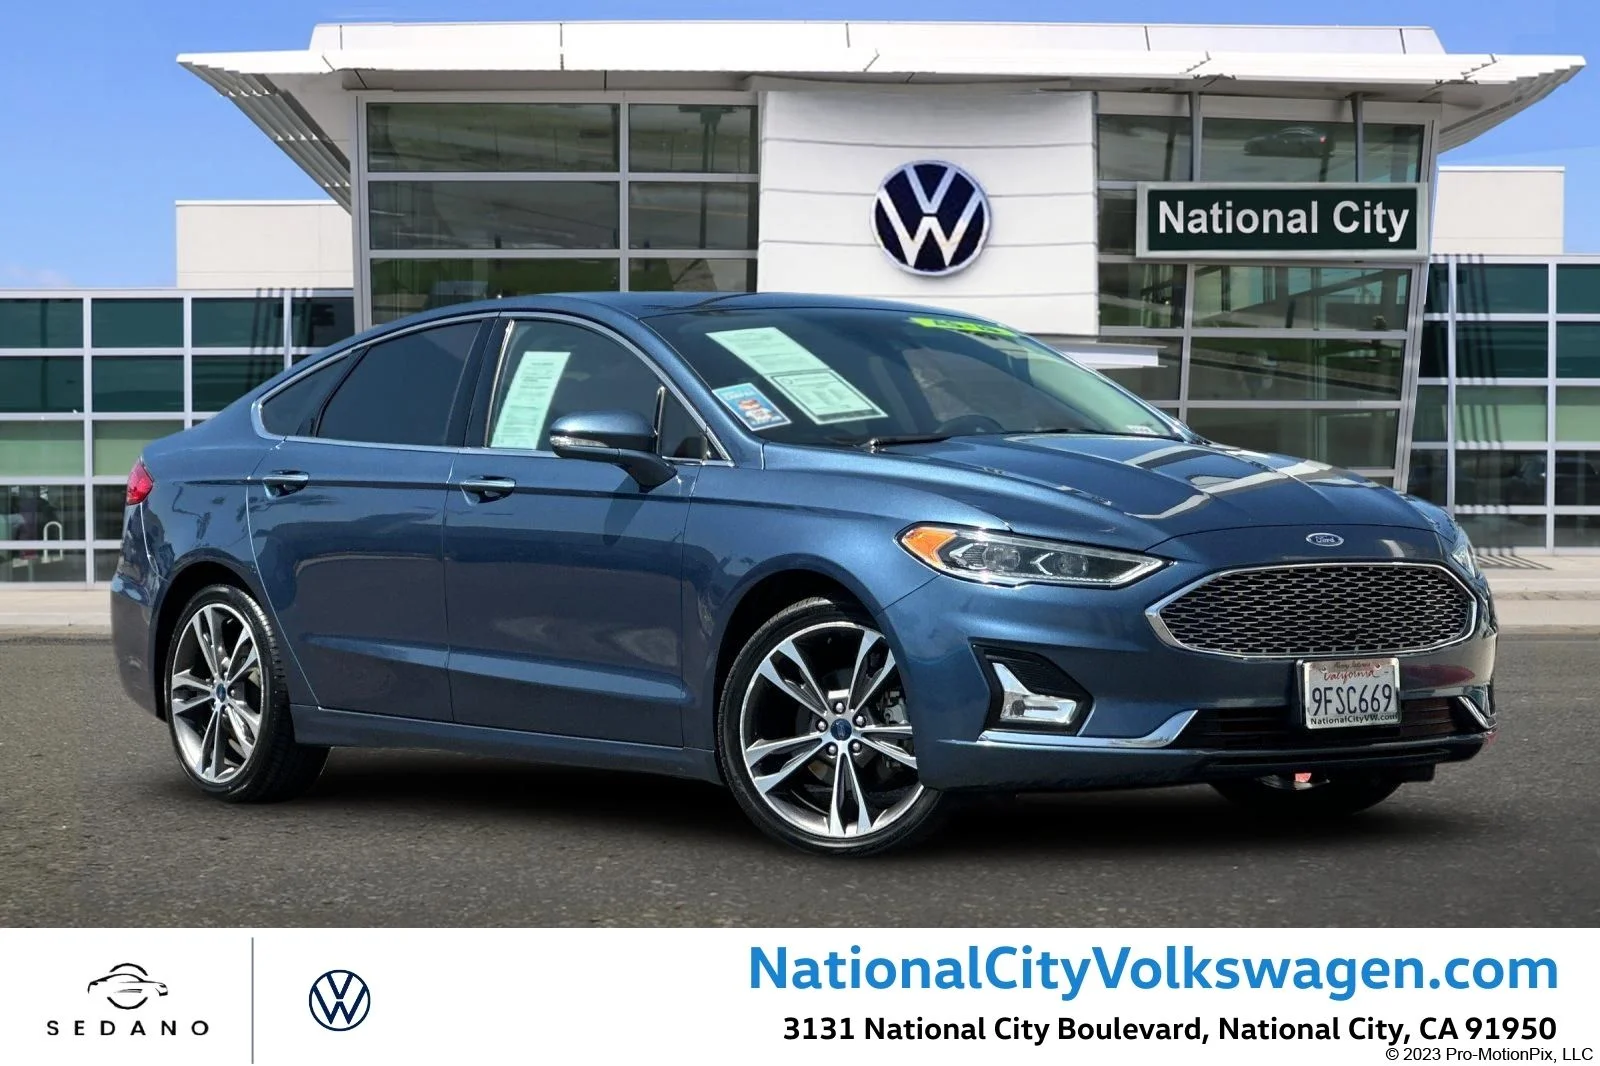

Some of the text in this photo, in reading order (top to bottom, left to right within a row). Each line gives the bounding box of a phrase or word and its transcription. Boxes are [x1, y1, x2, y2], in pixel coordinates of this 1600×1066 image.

[1159, 200, 1410, 243] National City
[1323, 669, 1380, 685] California
[1311, 684, 1393, 716] 9FSC669
[1310, 712, 1399, 725] NationalCityVW.com
